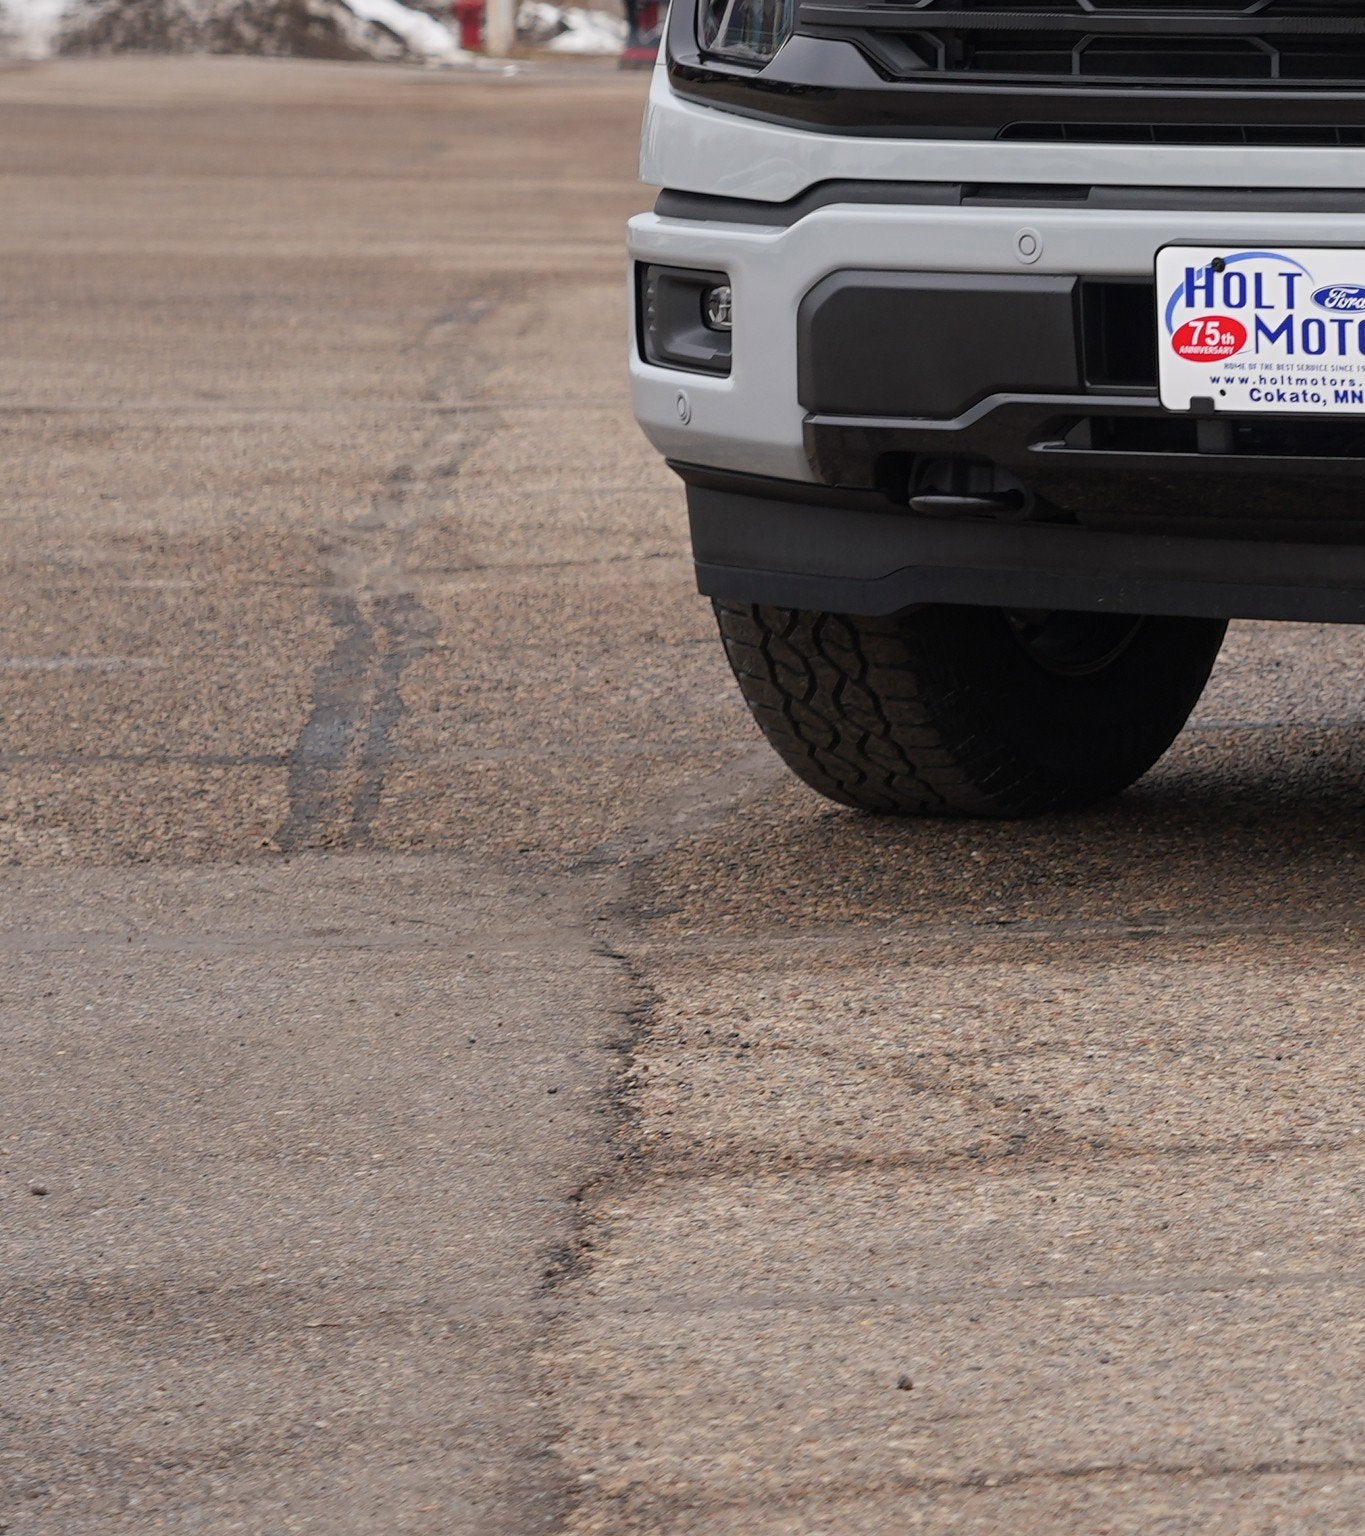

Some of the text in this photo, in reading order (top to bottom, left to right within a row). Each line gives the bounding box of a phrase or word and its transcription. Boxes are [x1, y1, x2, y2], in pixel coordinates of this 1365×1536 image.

[1188, 320, 1236, 346] 75th
[1179, 345, 1235, 355] ANNIVERSARY
[1249, 387, 1364, 406] Cokato, MN
